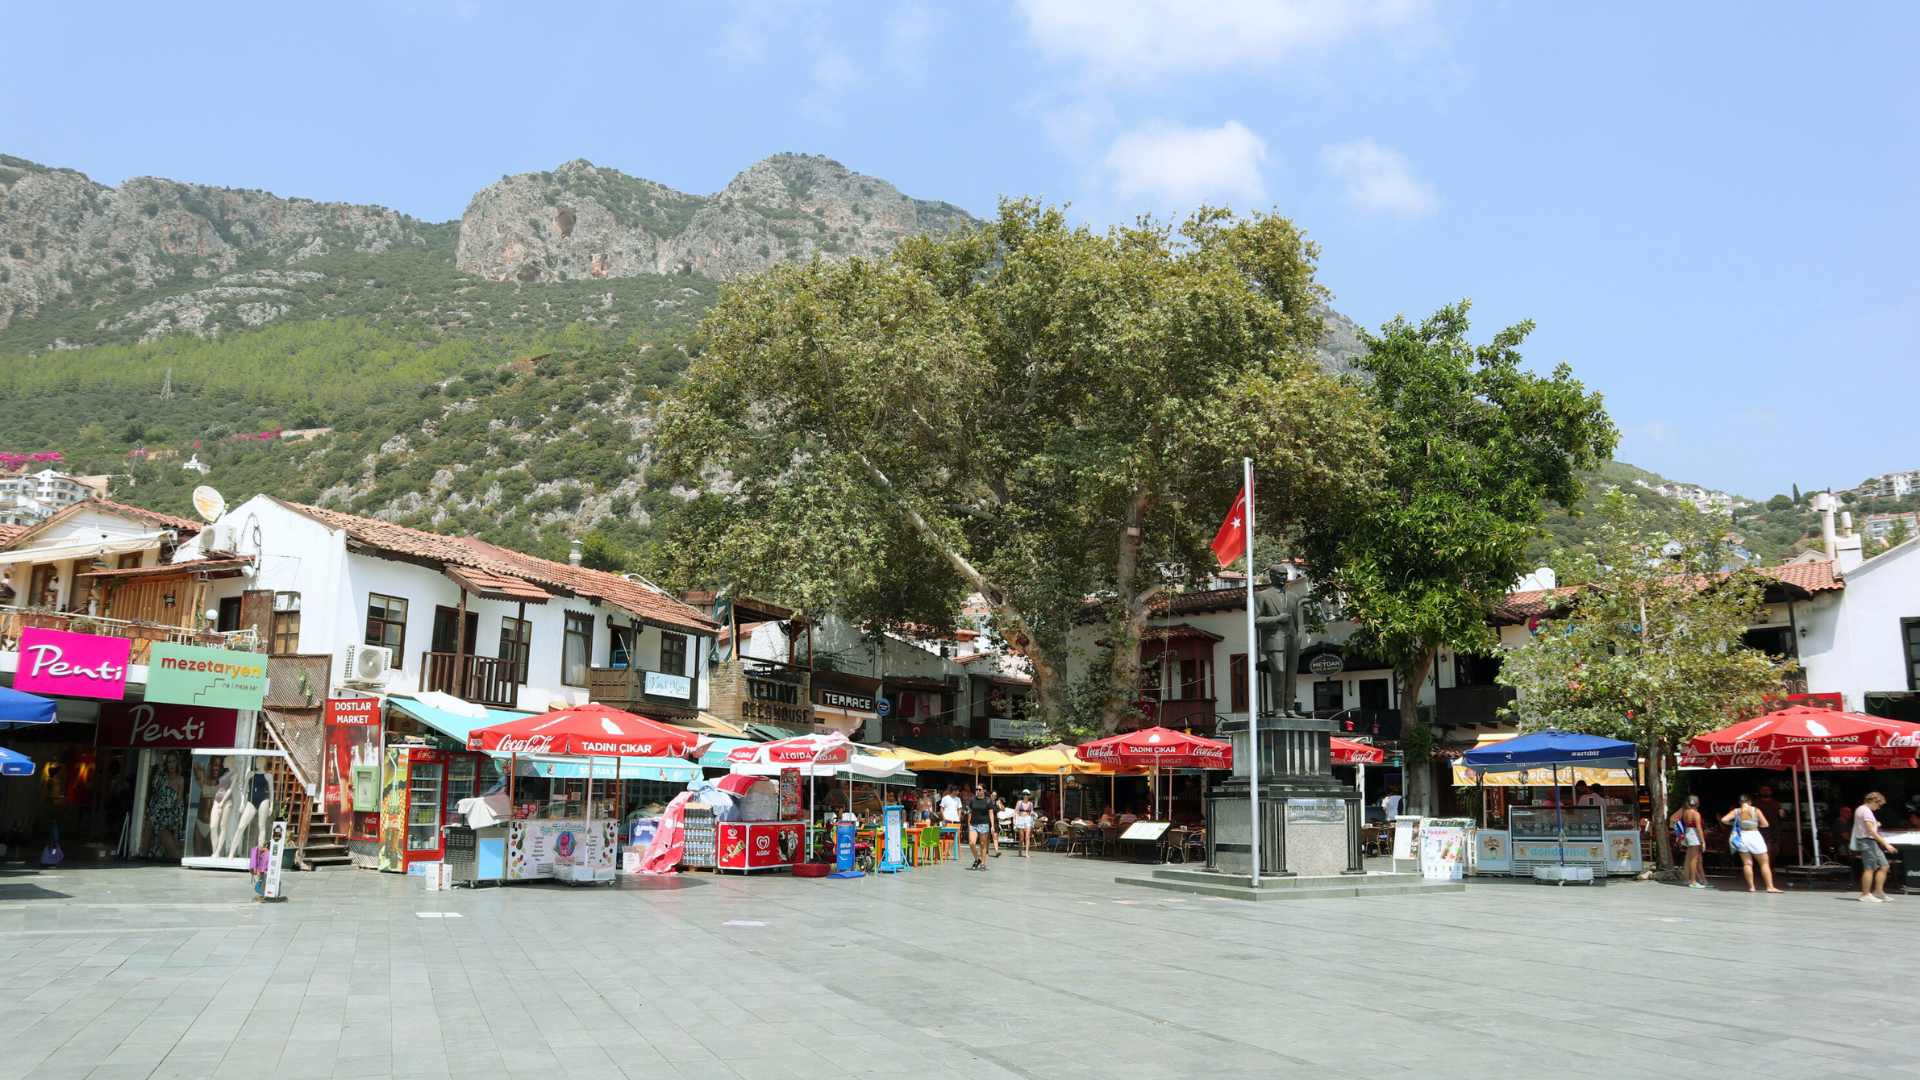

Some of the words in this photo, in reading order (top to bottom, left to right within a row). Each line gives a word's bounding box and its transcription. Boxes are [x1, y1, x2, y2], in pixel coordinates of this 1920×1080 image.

[27, 644, 123, 681] Penti
[335, 702, 371, 711] DOSTLAR
[825, 693, 871, 709] TERRACE
[128, 704, 205, 745] Penti
[337, 715, 368, 724] MARKET
[619, 743, 652, 754] ÇIKAR
[779, 751, 812, 760] ALGIDA
